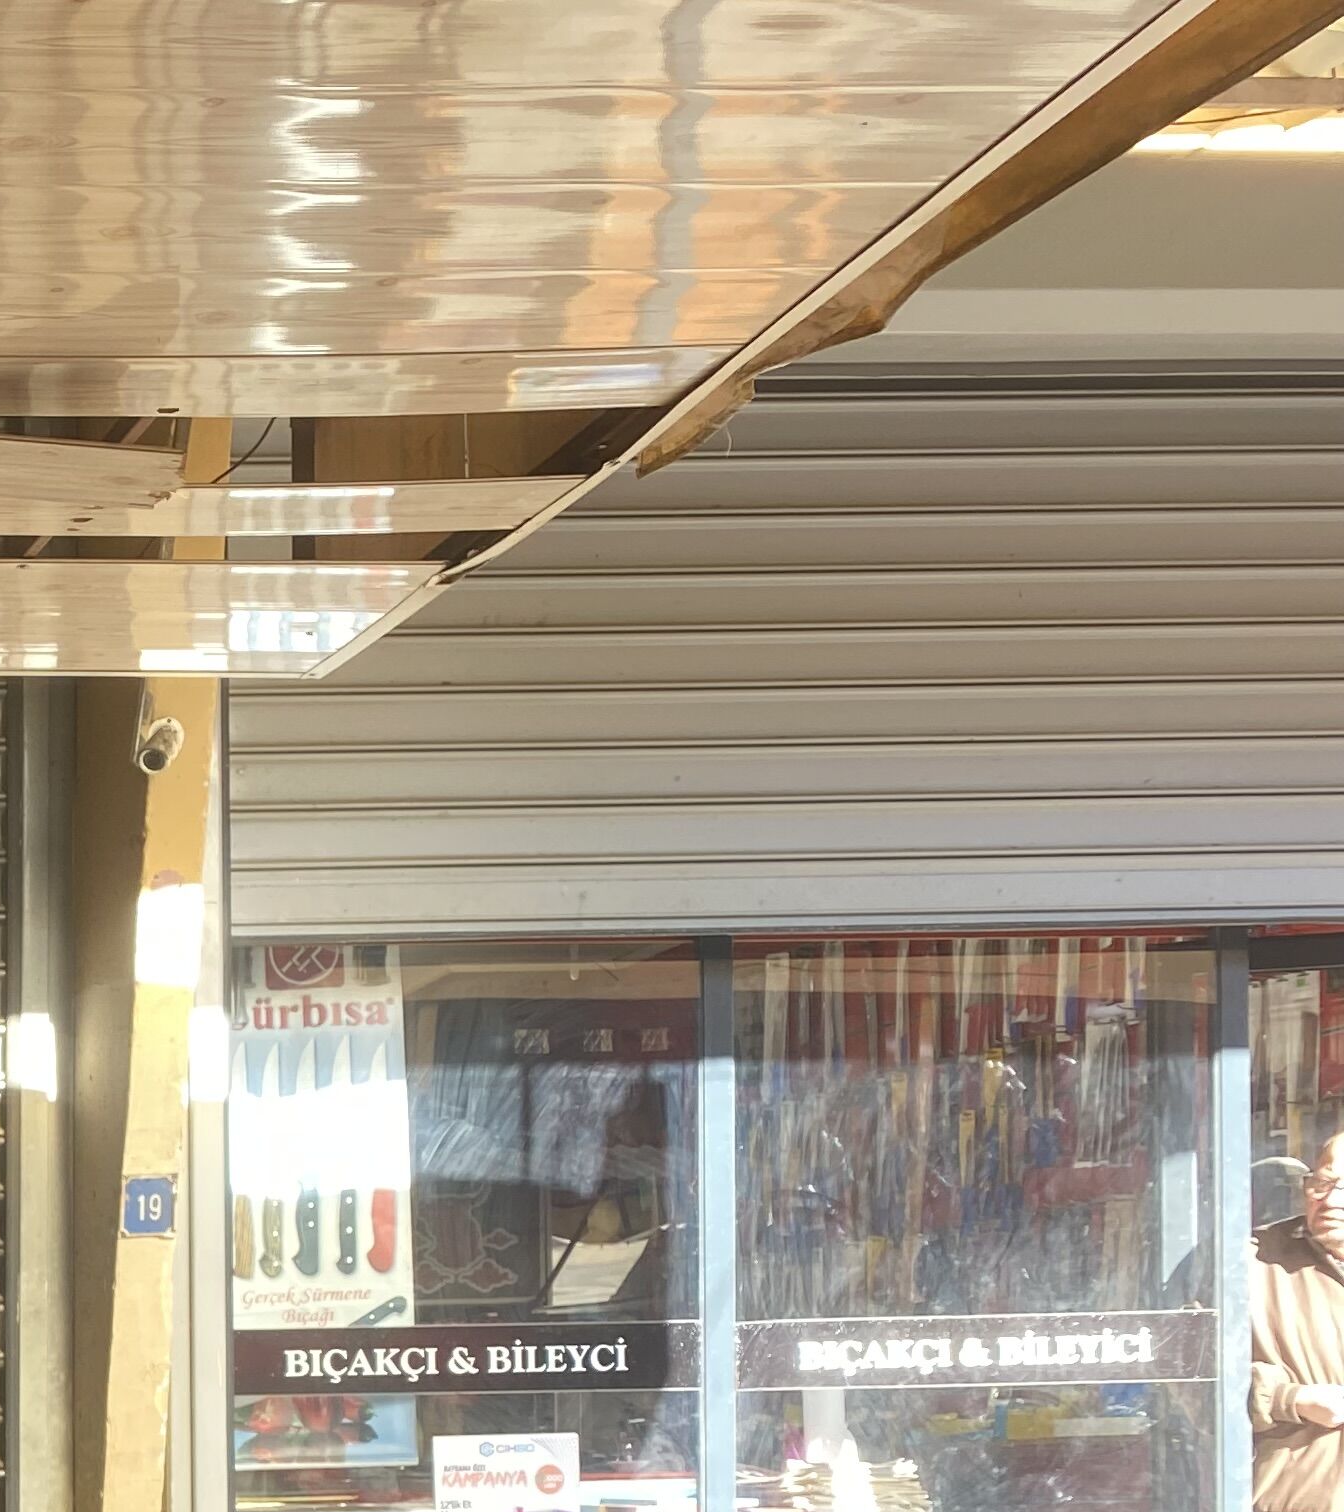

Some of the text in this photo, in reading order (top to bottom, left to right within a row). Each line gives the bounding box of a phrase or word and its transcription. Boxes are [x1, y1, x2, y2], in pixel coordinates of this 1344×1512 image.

[231, 995, 389, 1030] ürbısa
[137, 1193, 162, 1221] 19
[284, 1336, 629, 1383] BIÇAKÇI & BİLEYCİ
[798, 1338, 953, 1376] BIÇAKÇI
[959, 1338, 992, 1368] &
[442, 1470, 527, 1488] KAMPANYA
